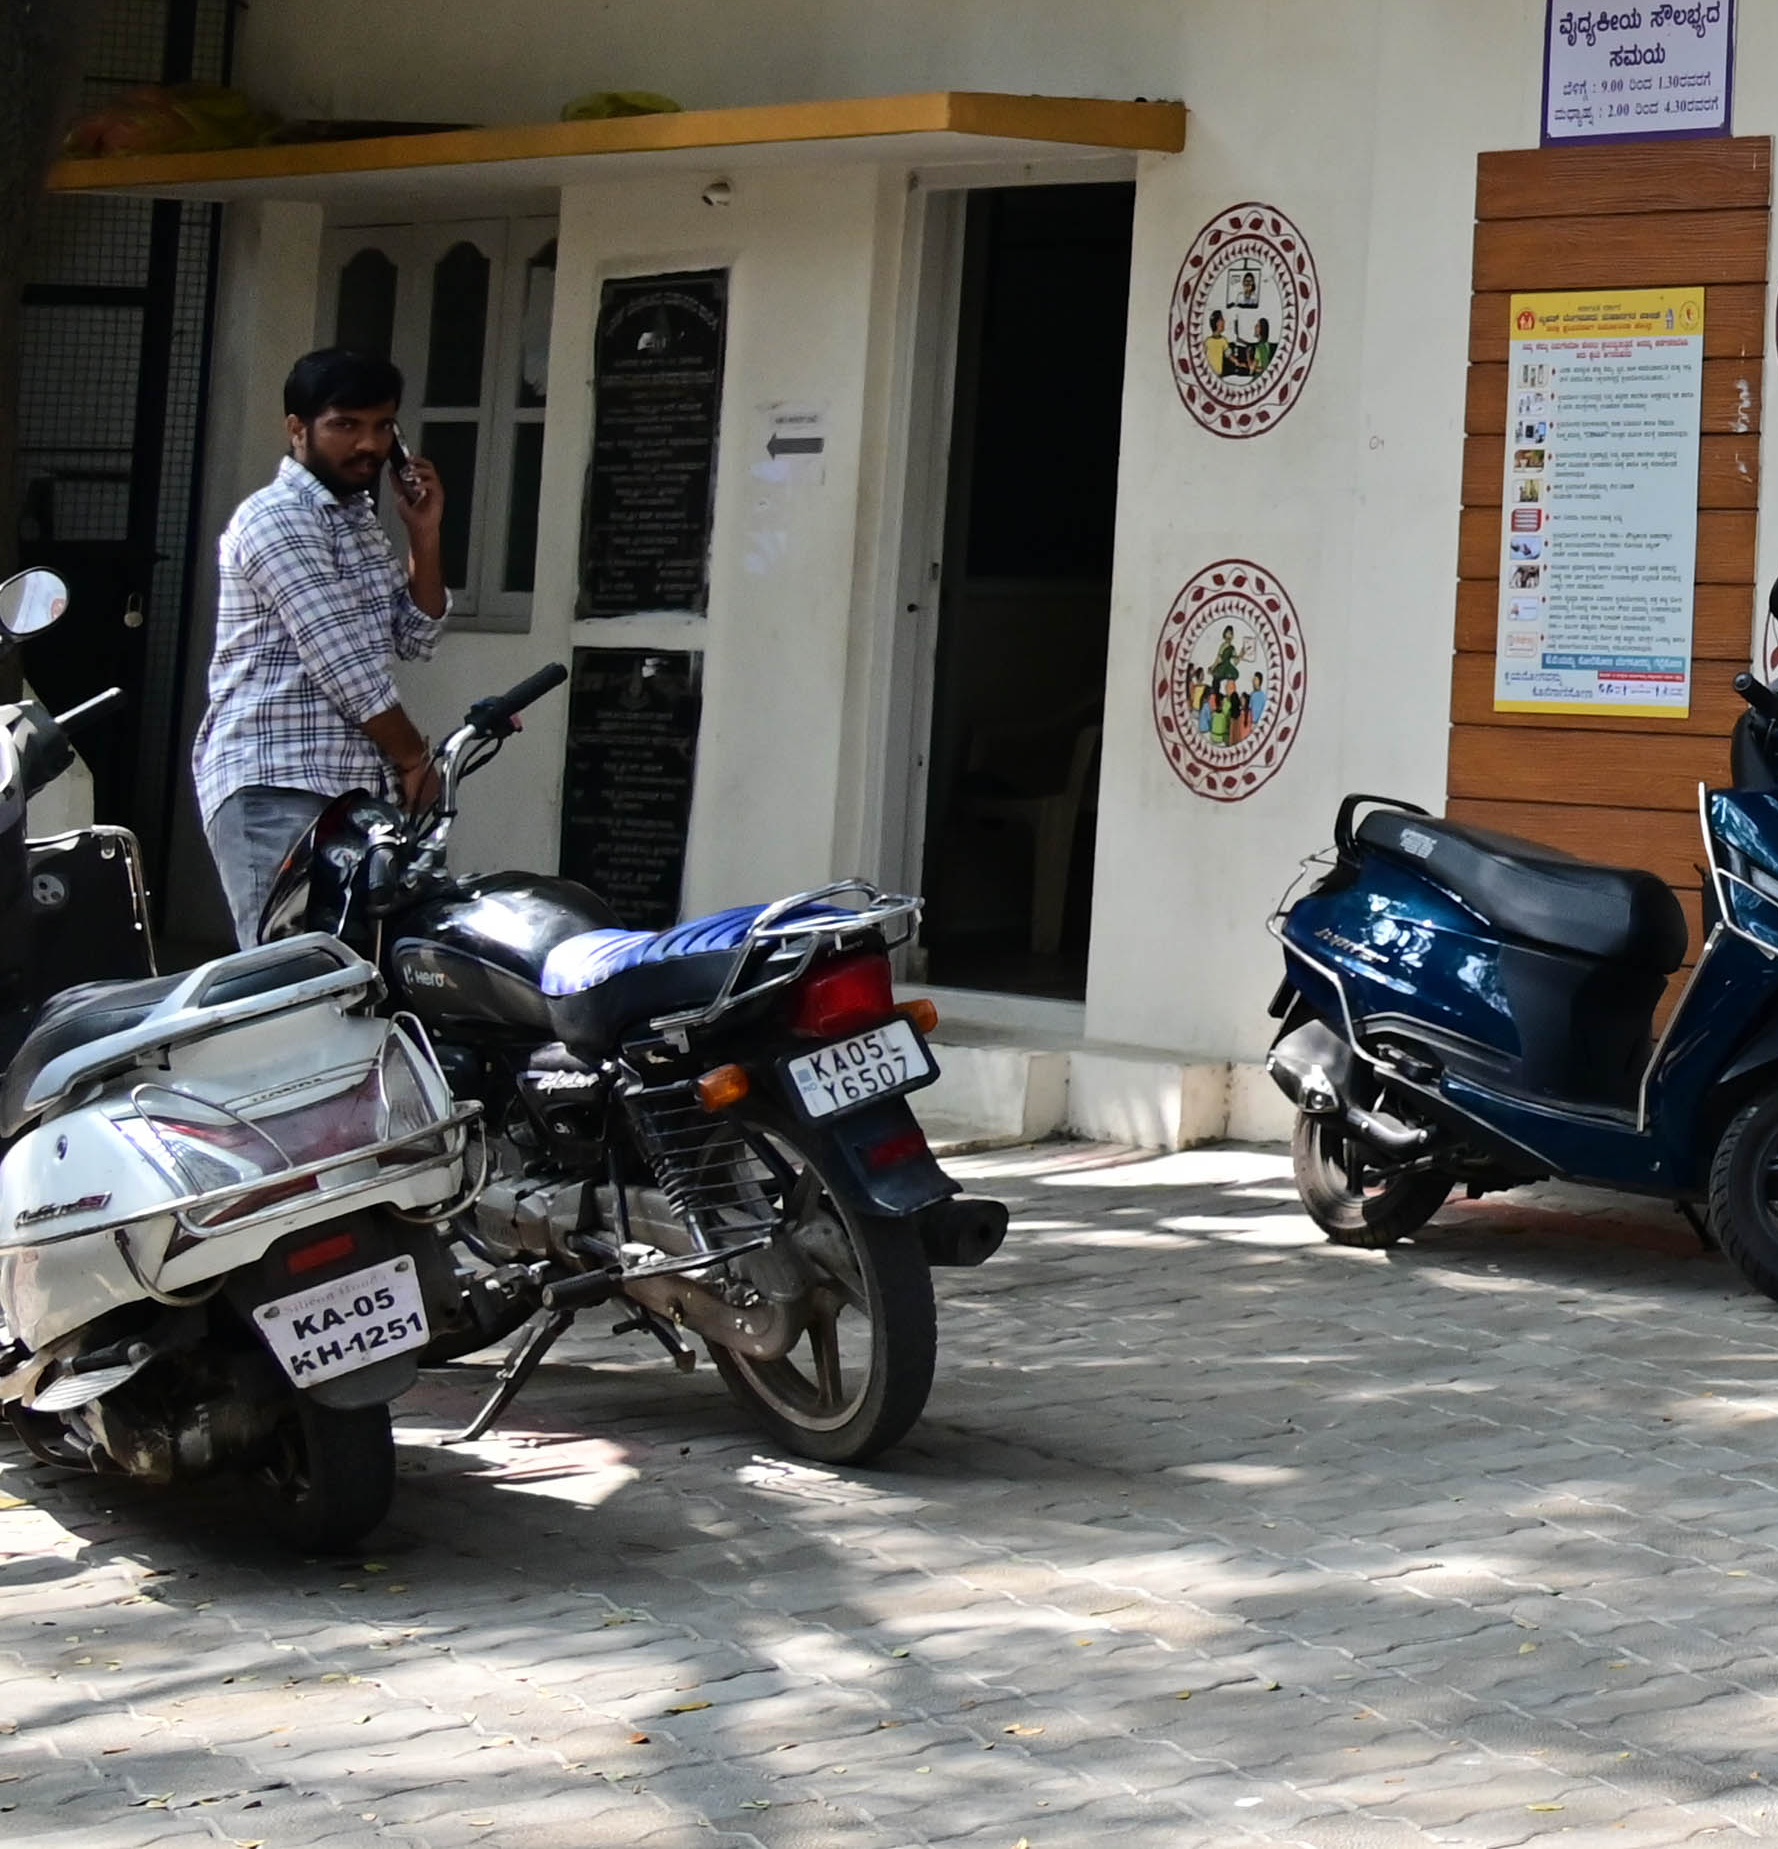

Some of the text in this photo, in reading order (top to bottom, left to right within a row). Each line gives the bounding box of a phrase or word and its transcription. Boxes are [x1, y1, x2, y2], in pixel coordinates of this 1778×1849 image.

[1559, 0, 1720, 46] ವೈದ್ಯಕೀಯ ಸೌಲಭ್ಯದ
[1609, 43, 1666, 68] ಸಮಯ
[1601, 78, 1624, 92] 9.00
[1608, 104, 1630, 118] 2.00
[809, 1030, 902, 1081] KA05L
[823, 1056, 908, 1109] Y6507
[292, 1287, 395, 1340] KA-05
[290, 1312, 423, 1376] KH-1251
